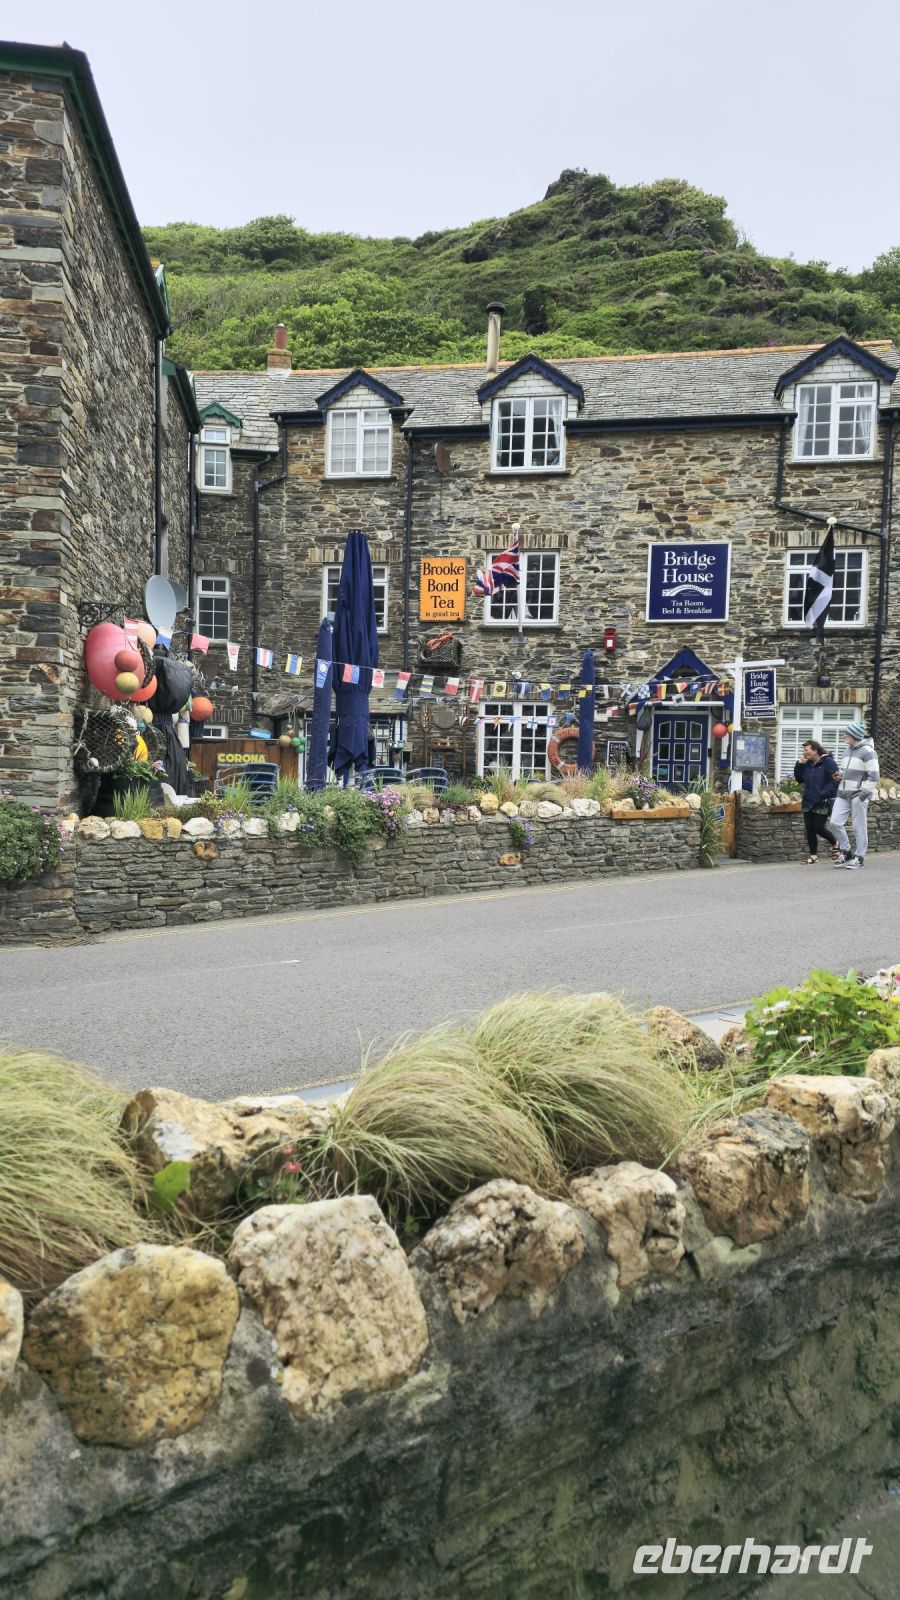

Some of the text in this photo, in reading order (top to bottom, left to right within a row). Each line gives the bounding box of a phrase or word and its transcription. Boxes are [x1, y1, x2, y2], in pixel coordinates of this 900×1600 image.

[663, 550, 716, 570] Bridge
[423, 562, 464, 575] Brooke
[662, 568, 714, 583] House
[427, 578, 459, 592] Bond
[430, 595, 455, 608] Tea
[750, 672, 769, 680] Bridge
[217, 753, 266, 763] CORONA
